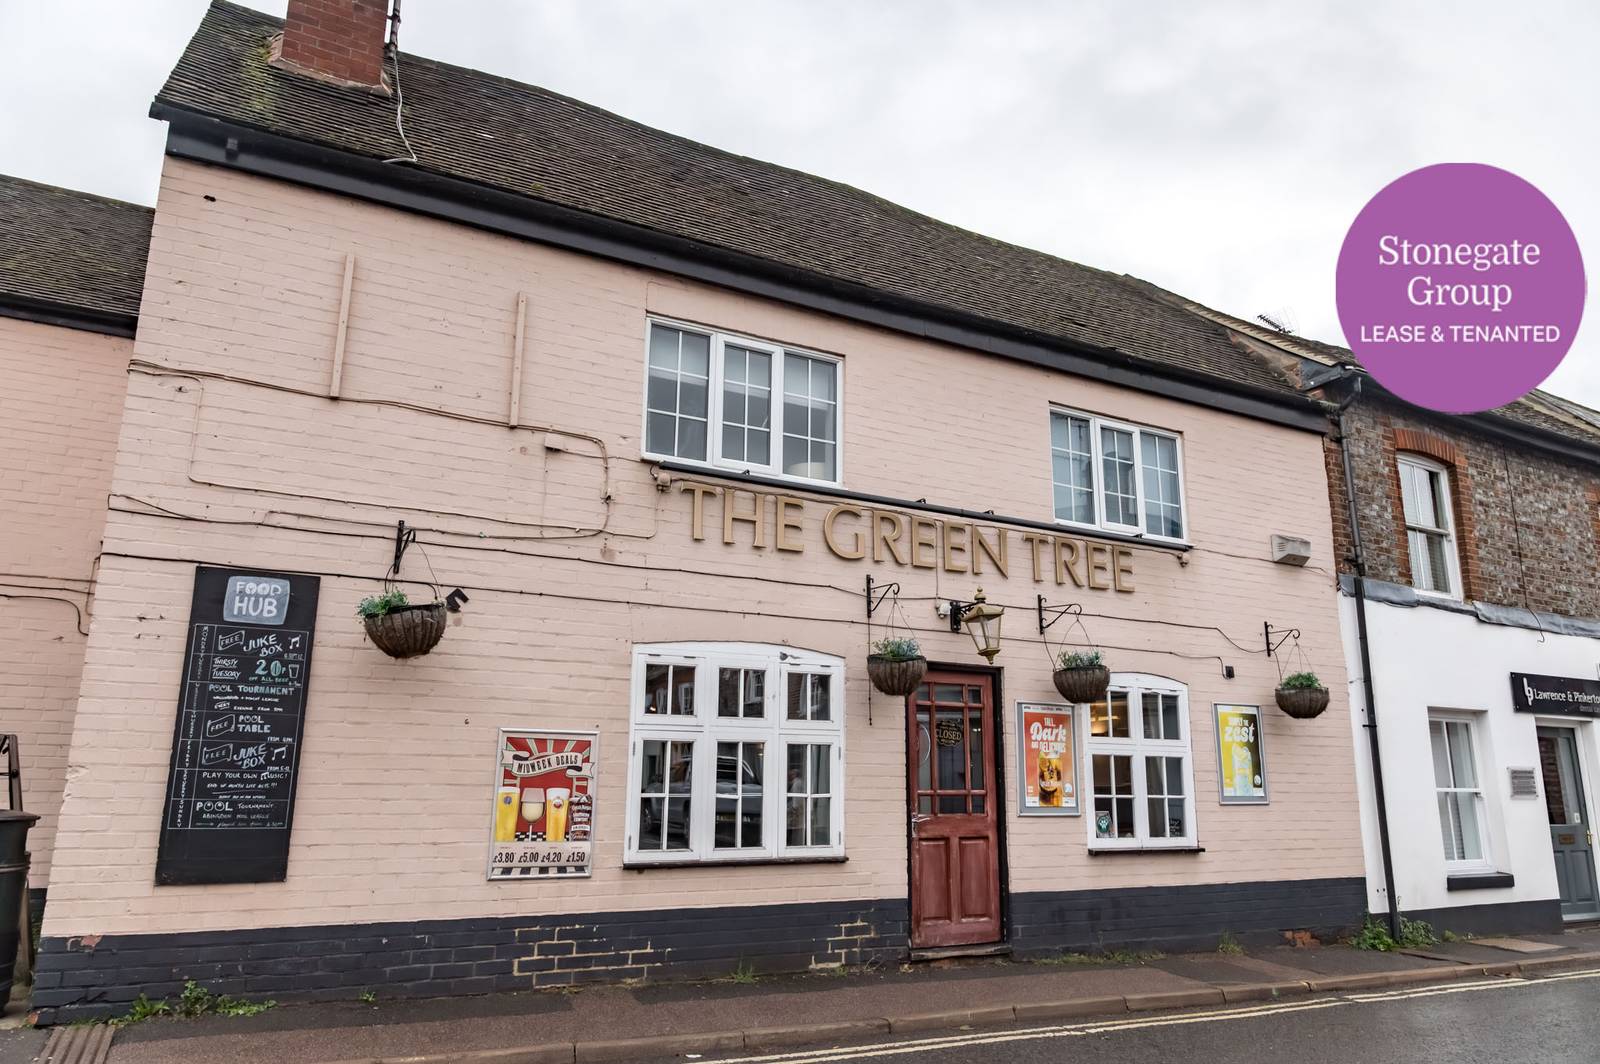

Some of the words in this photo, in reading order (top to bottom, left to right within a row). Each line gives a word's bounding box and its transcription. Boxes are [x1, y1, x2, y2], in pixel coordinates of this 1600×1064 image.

[680, 481, 805, 552] THE
[823, 504, 1010, 580] GREEN
[1023, 532, 1136, 593] TREE
[236, 581, 281, 596] FOOD
[233, 596, 278, 617] HUB
[220, 635, 240, 646] FREE
[243, 634, 278, 652] JUKE
[259, 643, 284, 657] BOX
[213, 658, 238, 667] THIRSTY
[212, 669, 242, 680] TUESDAY
[209, 684, 233, 693] POOL
[237, 685, 295, 696] TOURNAMENT
[1534, 689, 1566, 702] Lawrence
[239, 714, 264, 724] POOL
[237, 724, 271, 733] TABLE
[1030, 722, 1067, 742] Dark
[233, 743, 268, 761] JUKE
[242, 755, 266, 769] BOX
[517, 757, 553, 774] MIDWEEK
[555, 754, 579, 767] DEALS
[202, 771, 222, 779] PLAY
[196, 802, 233, 812] POOL
[492, 852, 515, 864] £3.80
[518, 852, 539, 864] £5.00
[540, 852, 562, 864] £4.20
